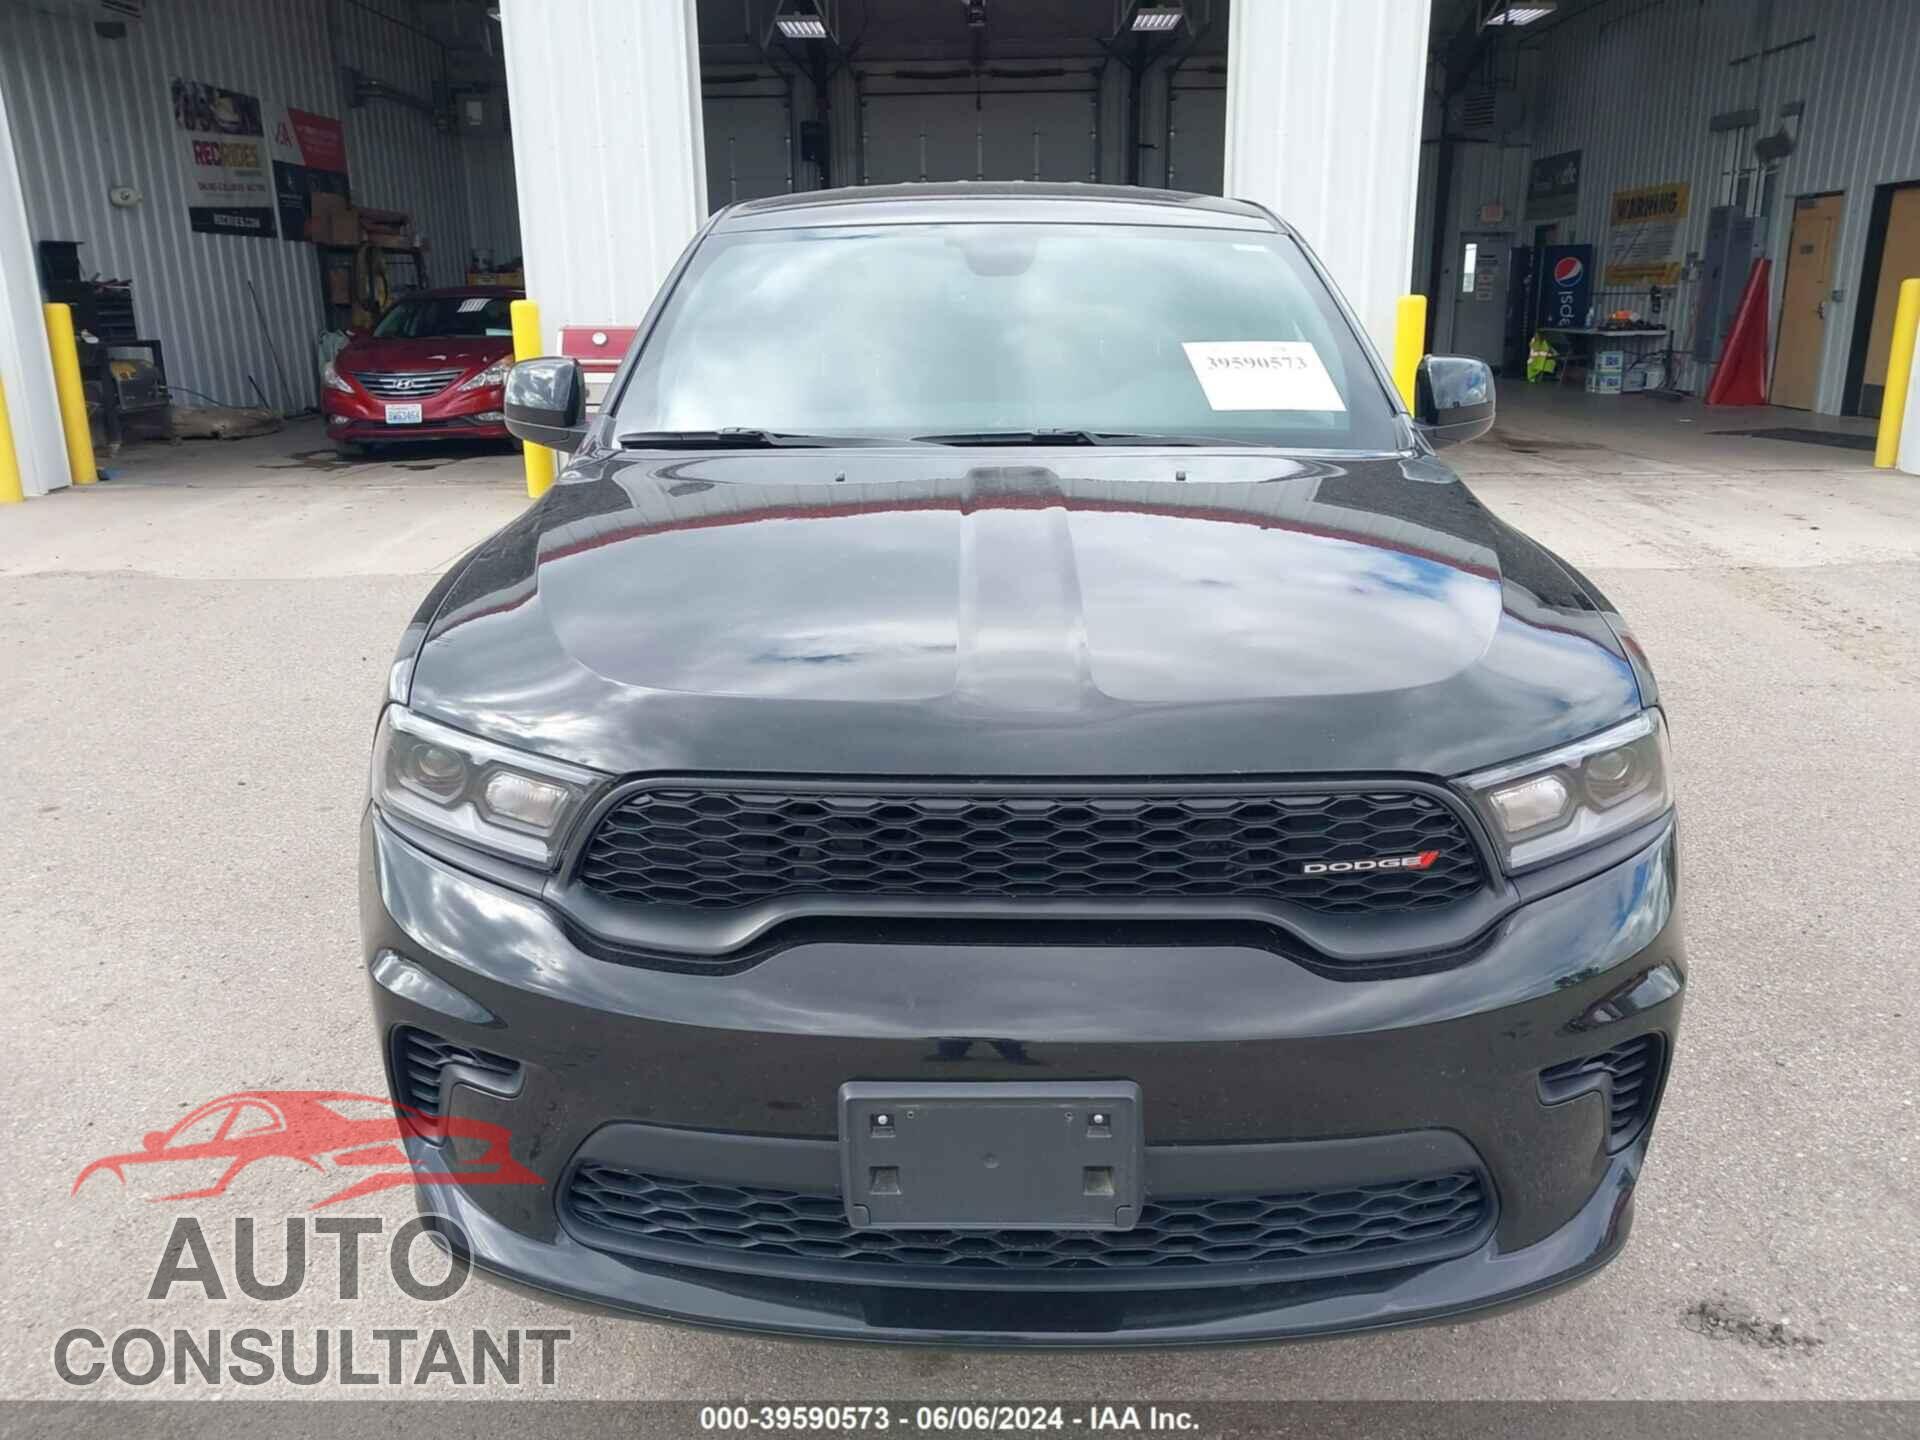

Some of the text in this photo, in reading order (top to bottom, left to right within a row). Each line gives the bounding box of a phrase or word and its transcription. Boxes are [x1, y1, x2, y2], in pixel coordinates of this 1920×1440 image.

[1616, 192, 1678, 218] WARNING
[1557, 291, 1575, 326] epsi
[1207, 356, 1308, 370] 39590573
[1304, 856, 1422, 873] DODGE
